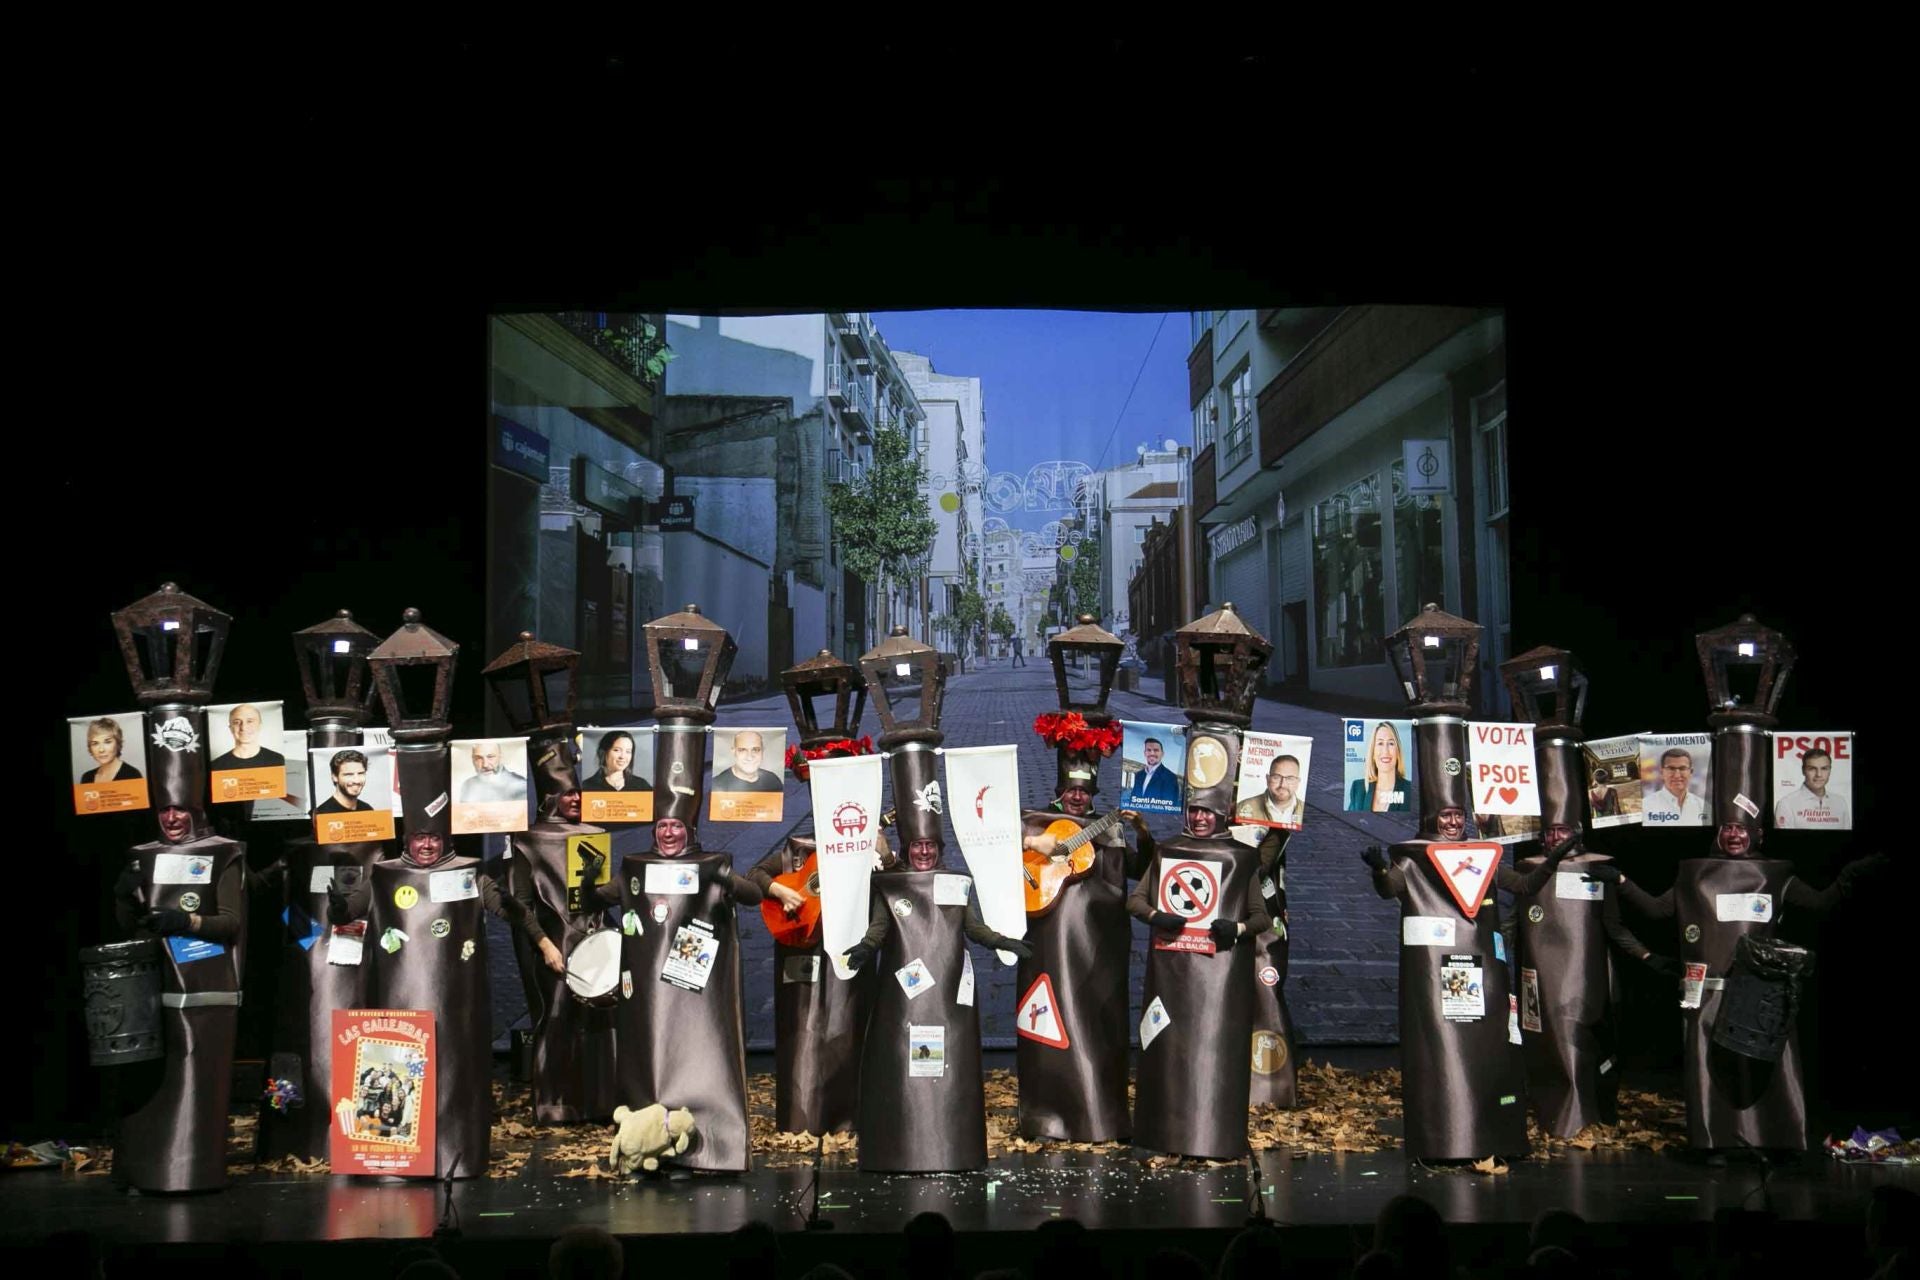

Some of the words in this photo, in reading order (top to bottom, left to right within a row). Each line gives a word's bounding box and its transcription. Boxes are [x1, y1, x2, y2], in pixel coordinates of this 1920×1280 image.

[1477, 726, 1527, 746] VOTA
[1665, 736, 1706, 746] MOMENTO
[1777, 736, 1850, 759] PSOE
[1479, 764, 1530, 784] PSOE
[1150, 797, 1173, 805] Amaro
[1648, 811, 1679, 823] feijóo
[825, 839, 872, 854] MERIDA
[1193, 935, 1212, 943] JUGA
[338, 1024, 361, 1046] LAS
